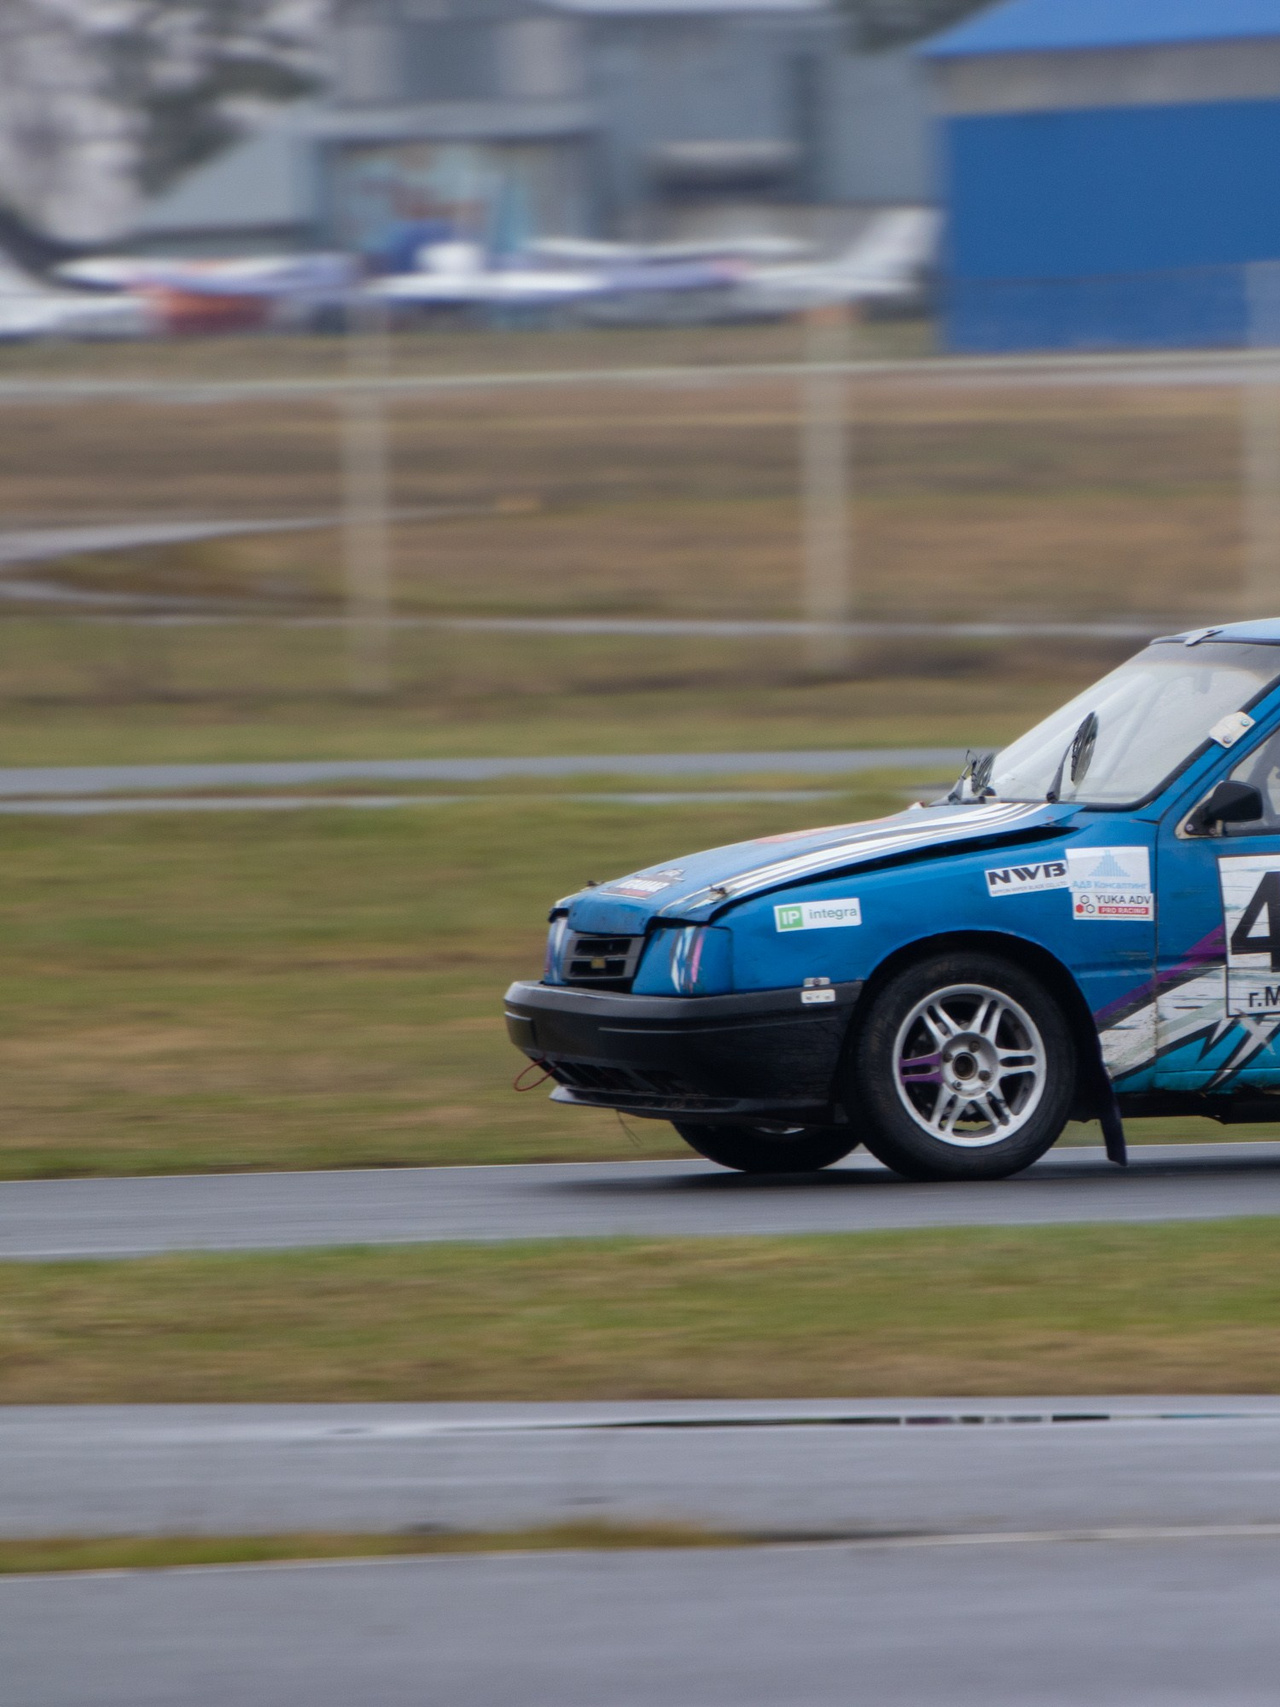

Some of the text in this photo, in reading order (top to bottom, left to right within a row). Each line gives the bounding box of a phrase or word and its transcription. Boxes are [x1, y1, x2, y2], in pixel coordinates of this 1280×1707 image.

[988, 862, 1067, 886] NWB
[1096, 894, 1151, 905] YUKA ADV
[781, 908, 857, 925] IP integra
[1118, 907, 1147, 915] RACING
